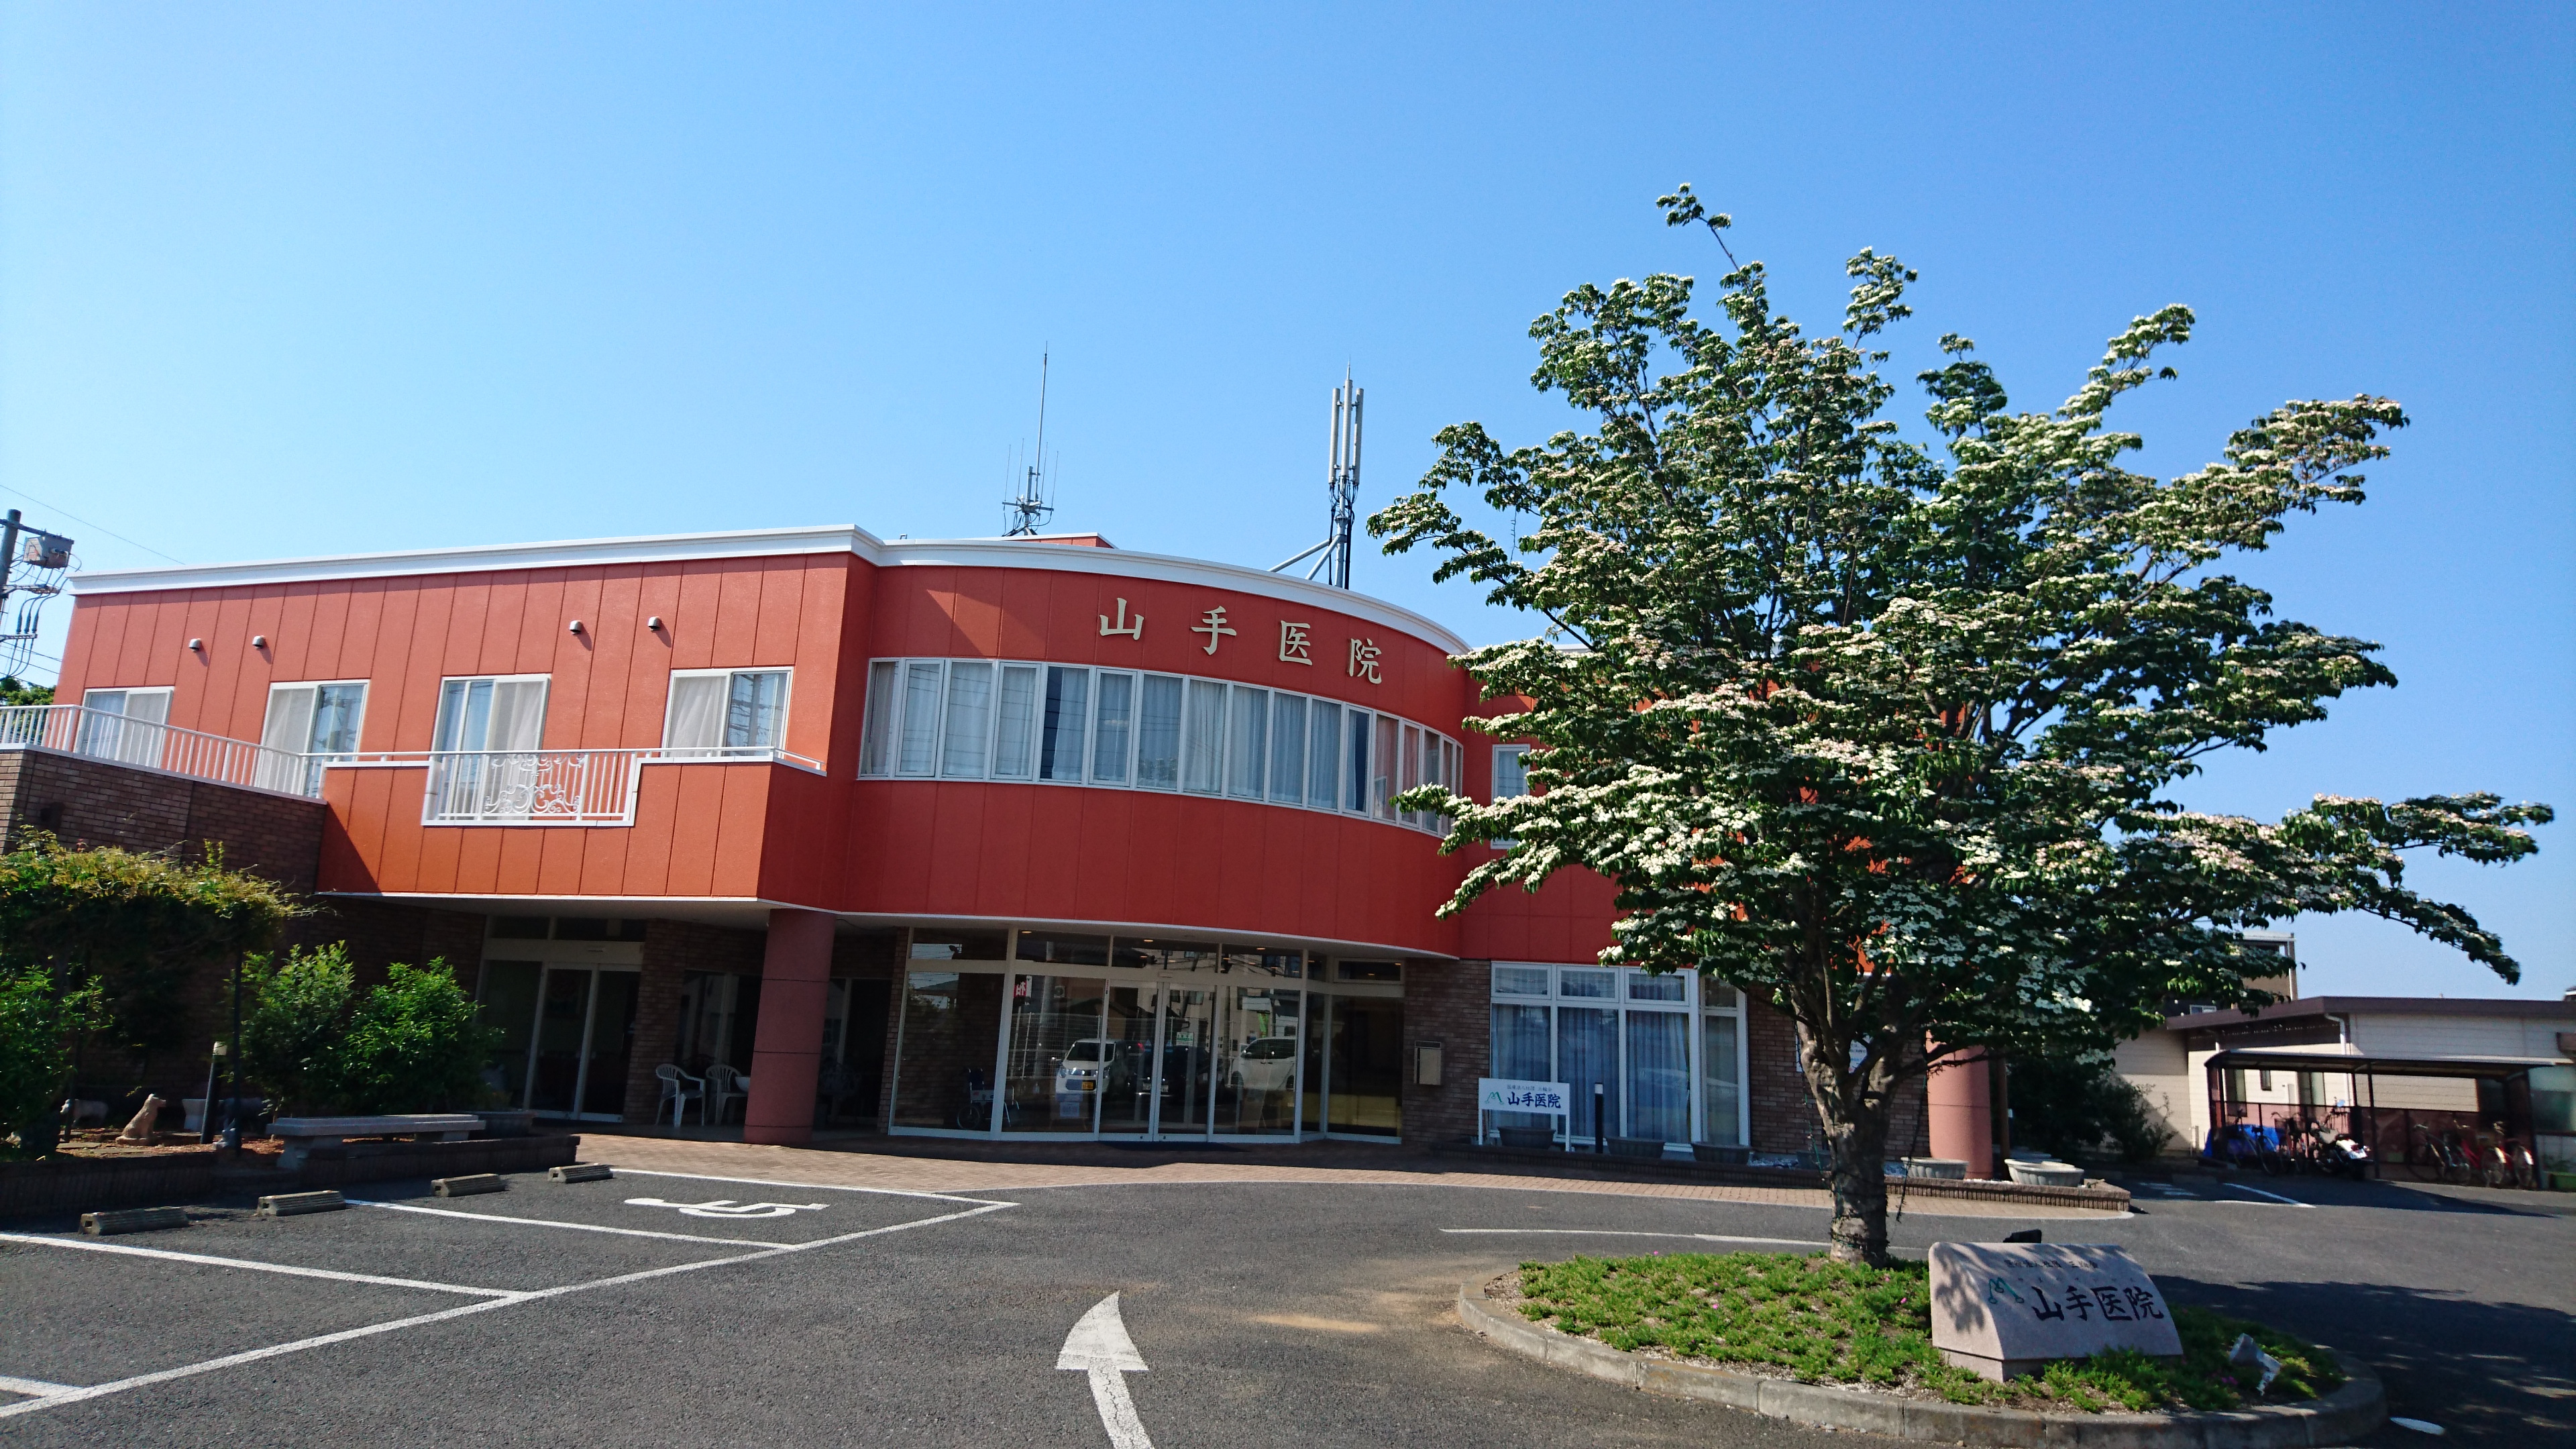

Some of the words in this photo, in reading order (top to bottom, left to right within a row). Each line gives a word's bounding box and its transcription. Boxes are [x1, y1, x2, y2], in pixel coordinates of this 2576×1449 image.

[1099, 597, 1383, 685] 山手医院
[1507, 1091, 1561, 1108] 山手医院
[2031, 1285, 2164, 1321] 山手医院
